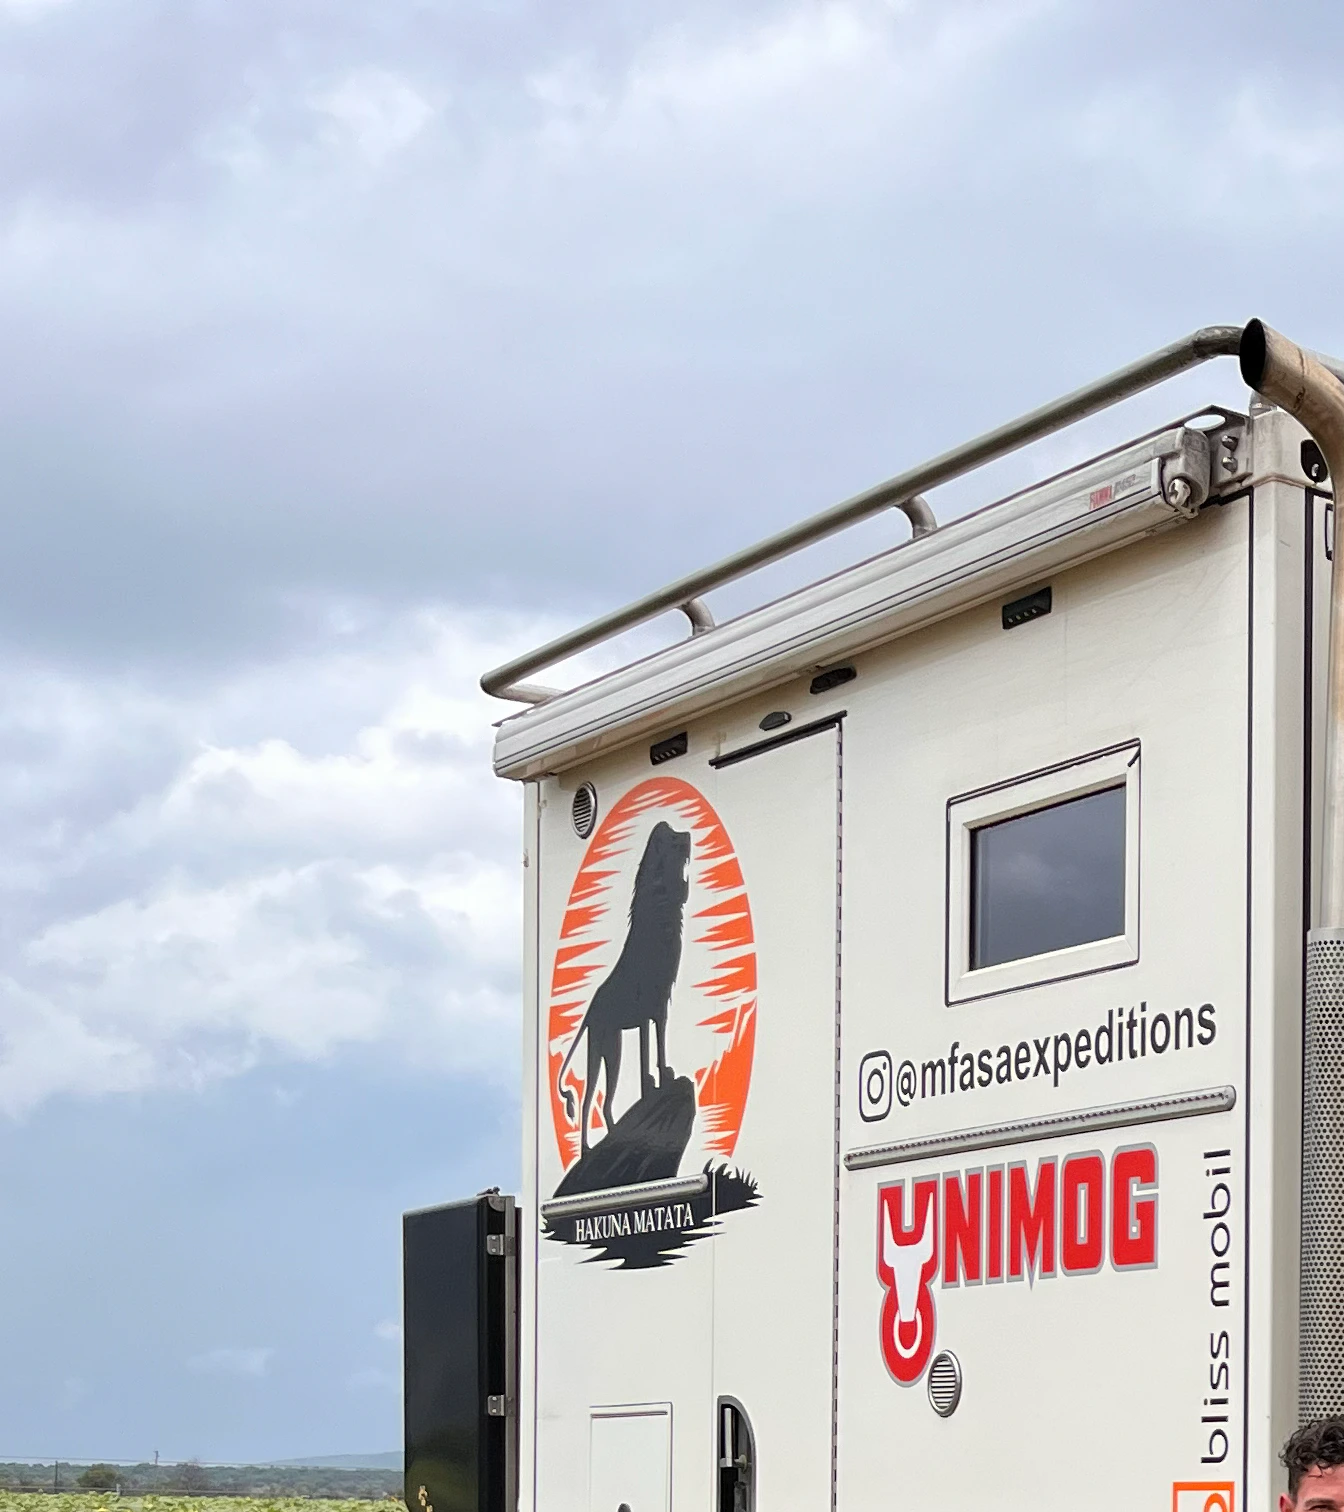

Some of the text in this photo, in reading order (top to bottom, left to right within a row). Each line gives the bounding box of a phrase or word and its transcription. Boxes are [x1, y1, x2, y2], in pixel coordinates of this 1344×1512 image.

[897, 1001, 1217, 1106] @mfasaexpeditions
[575, 1203, 695, 1242] HAKUNA MATATA
[876, 1142, 1159, 1388] UNIMOG
[1201, 1149, 1231, 1464] bliss mobil
